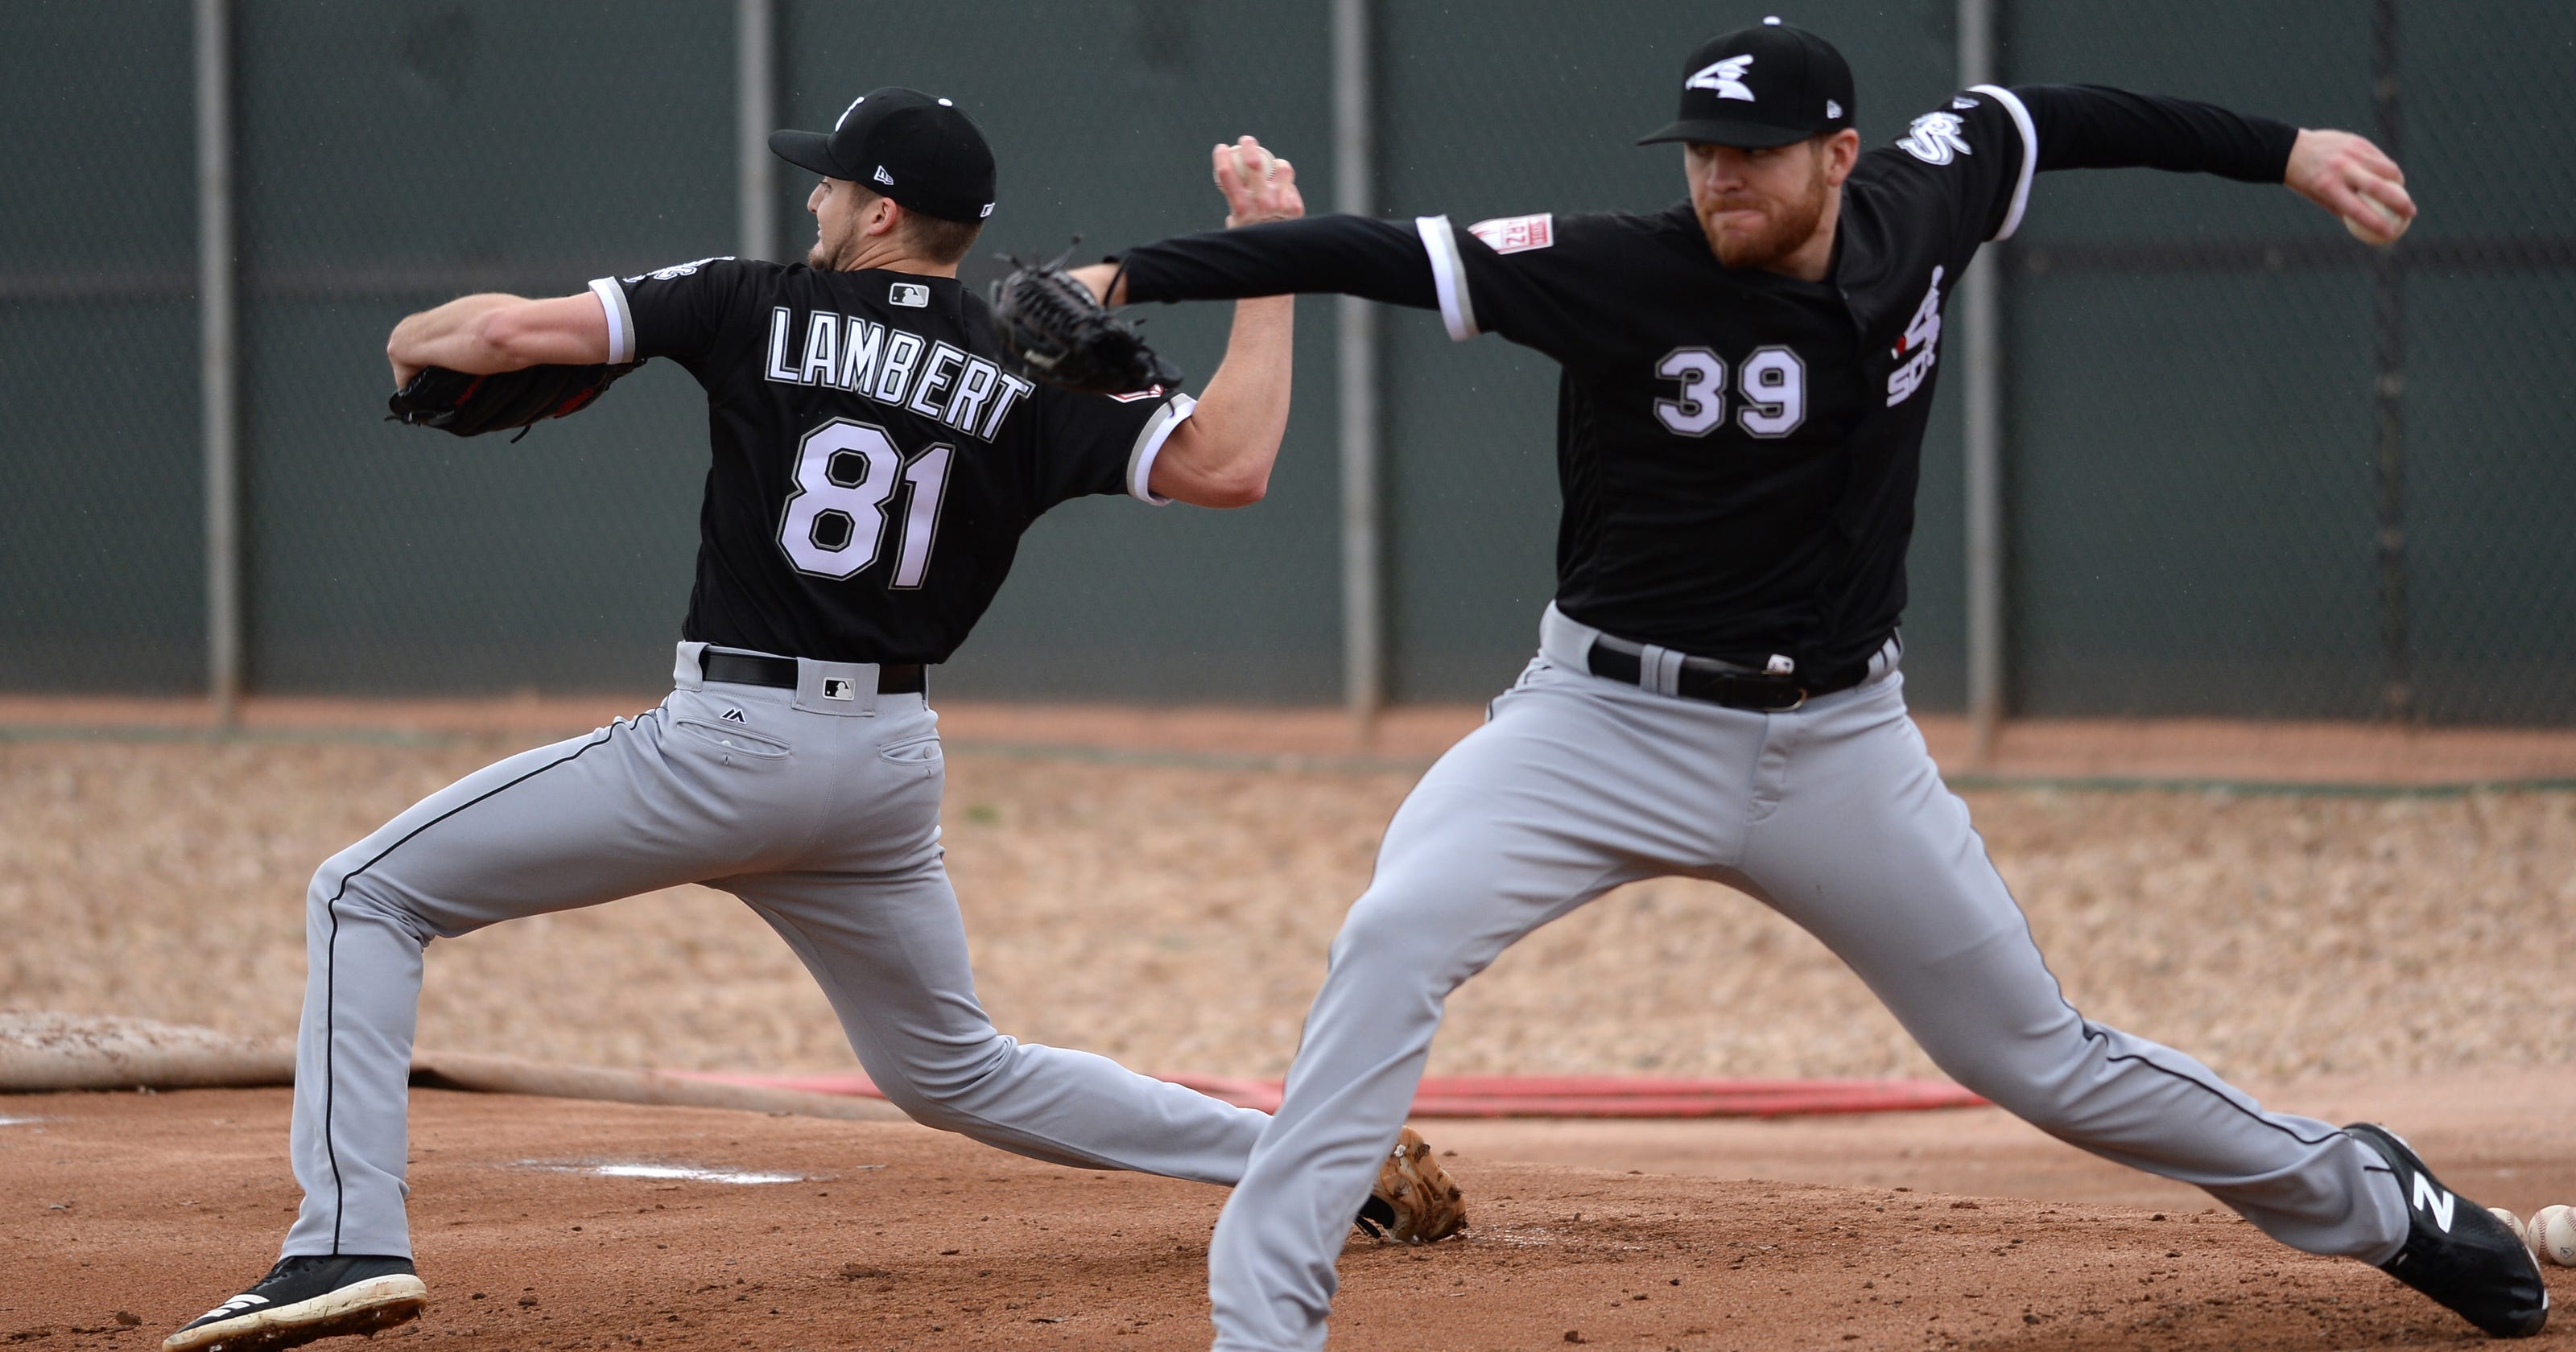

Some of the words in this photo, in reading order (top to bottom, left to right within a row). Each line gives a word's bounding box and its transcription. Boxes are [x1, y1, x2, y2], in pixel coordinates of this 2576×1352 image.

[765, 307, 1036, 443] LAMBERT
[1653, 344, 1806, 439] 39
[775, 416, 956, 590] 81
